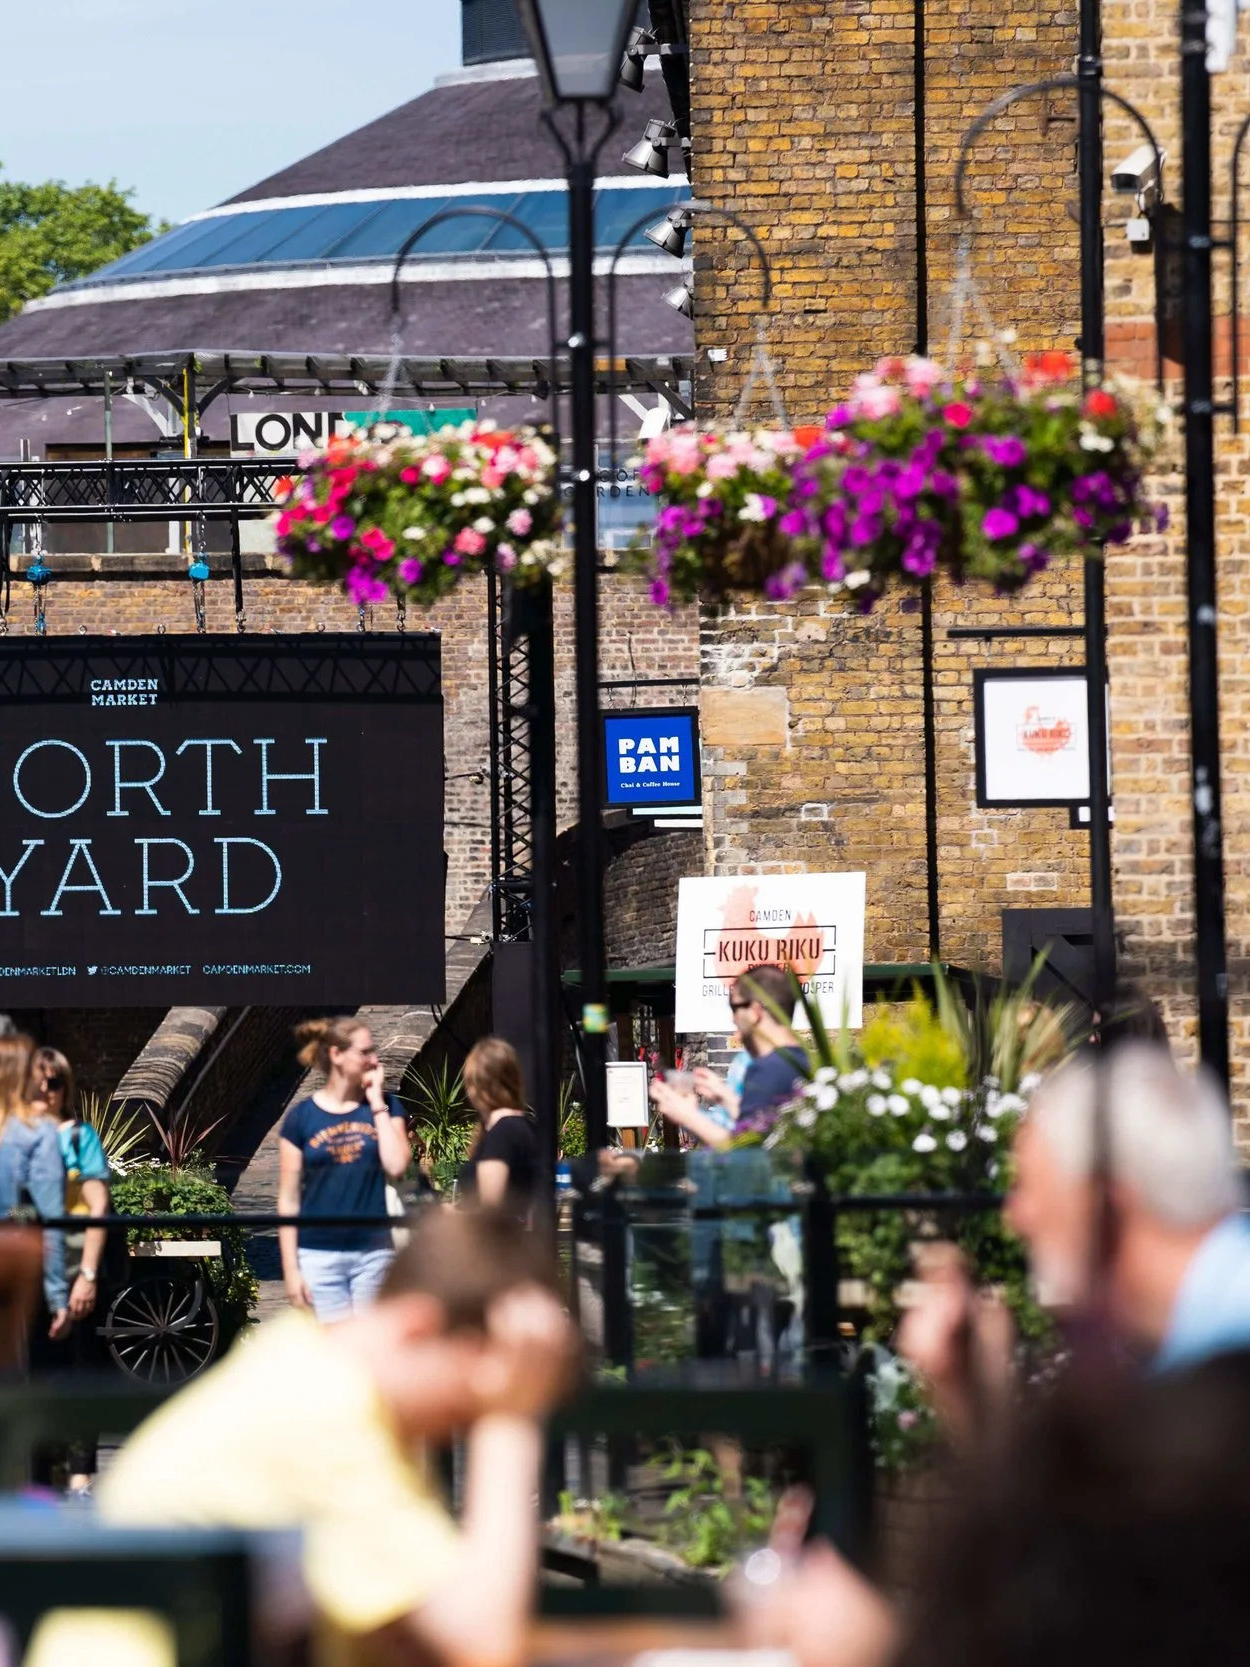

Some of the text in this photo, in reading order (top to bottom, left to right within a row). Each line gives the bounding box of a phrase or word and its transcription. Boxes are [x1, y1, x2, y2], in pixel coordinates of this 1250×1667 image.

[90, 679, 158, 691] CAMDEN
[91, 693, 158, 706] MARKET
[619, 736, 680, 755] PAM
[619, 755, 680, 773] BAN
[749, 909, 792, 922] CAMDEN
[719, 938, 820, 962] KUKU RIKU
[801, 981, 834, 995] OSPER
